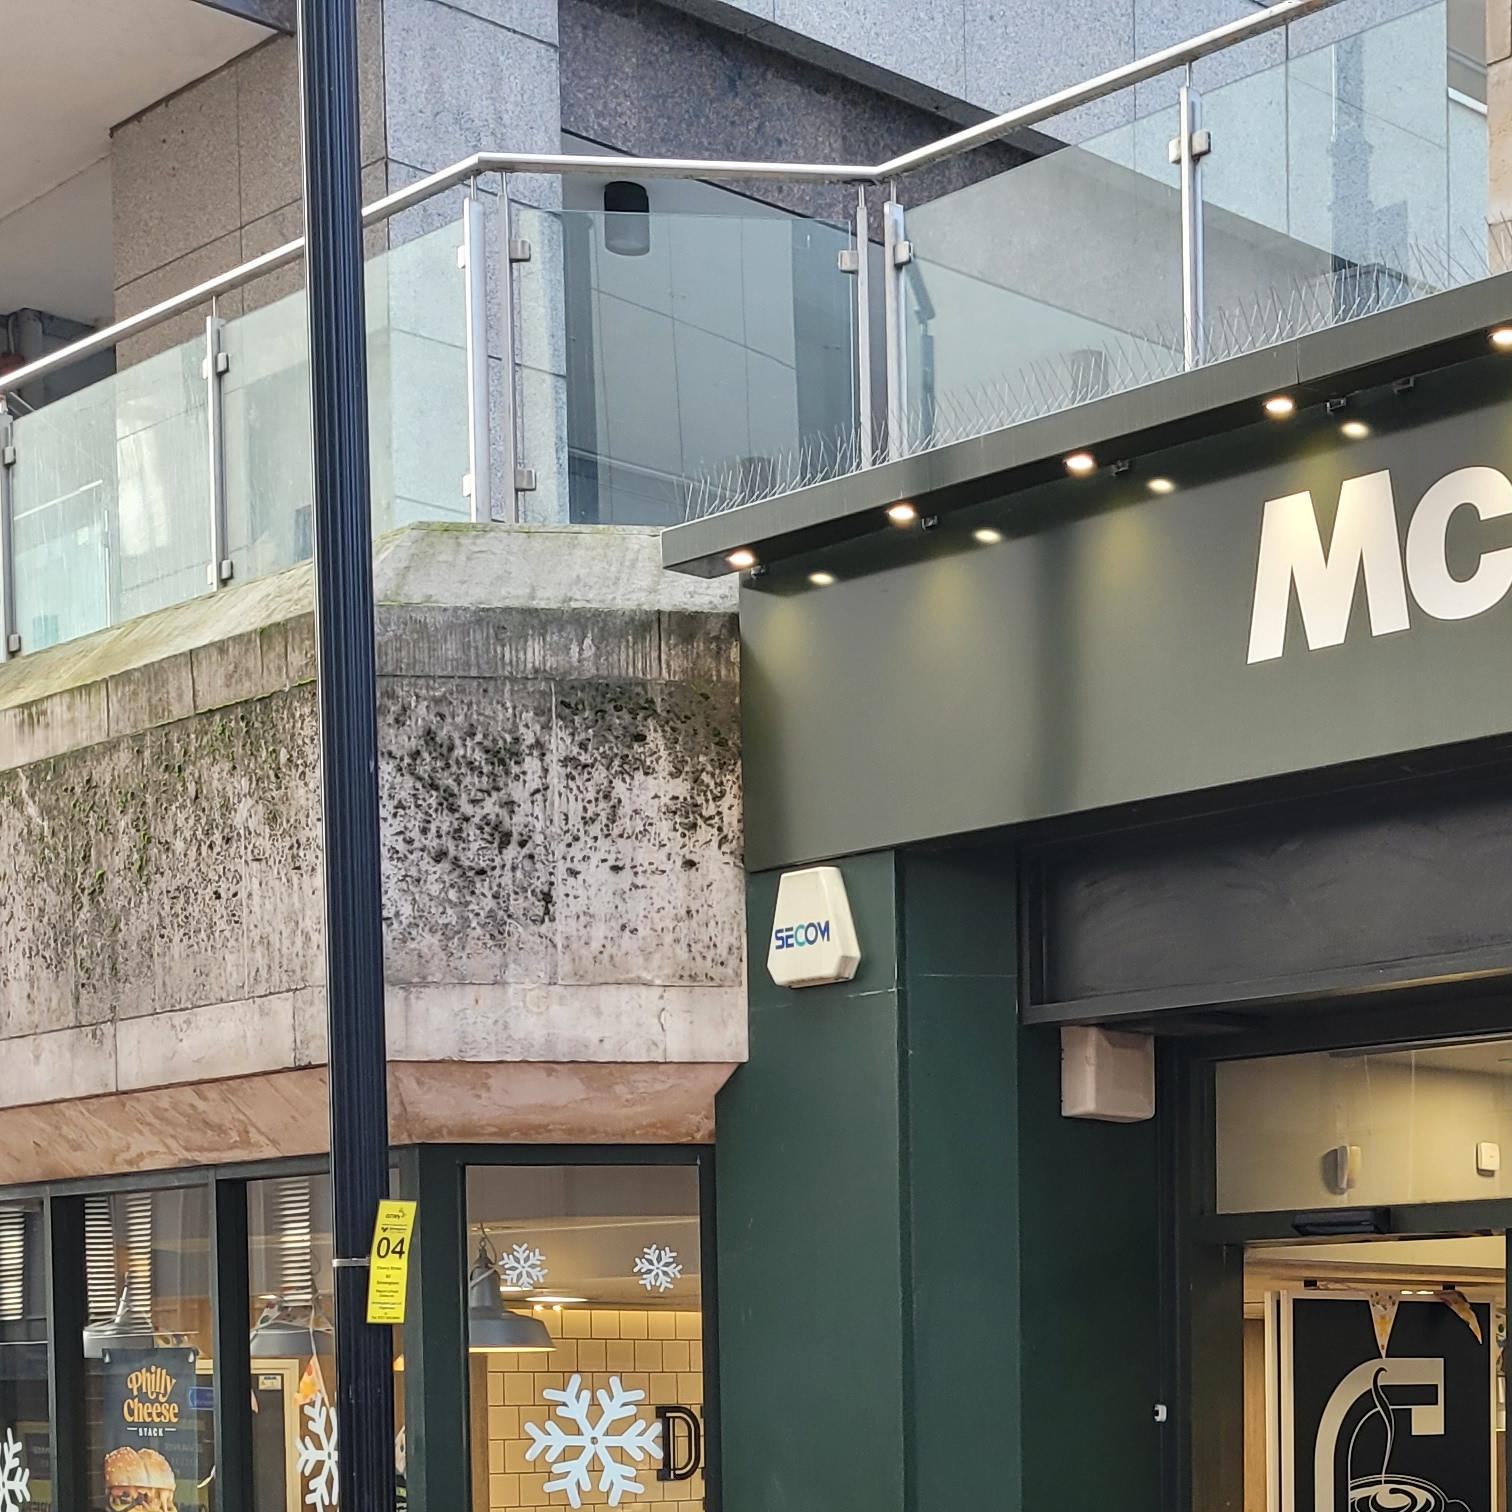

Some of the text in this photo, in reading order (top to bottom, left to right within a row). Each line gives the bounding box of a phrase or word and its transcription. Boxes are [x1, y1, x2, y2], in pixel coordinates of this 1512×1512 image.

[775, 920, 830, 950] SECOM
[377, 1237, 405, 1259] 04
[127, 1365, 177, 1403] Philly
[123, 1397, 179, 1423] Cheese
[138, 1427, 164, 1437] STACK
